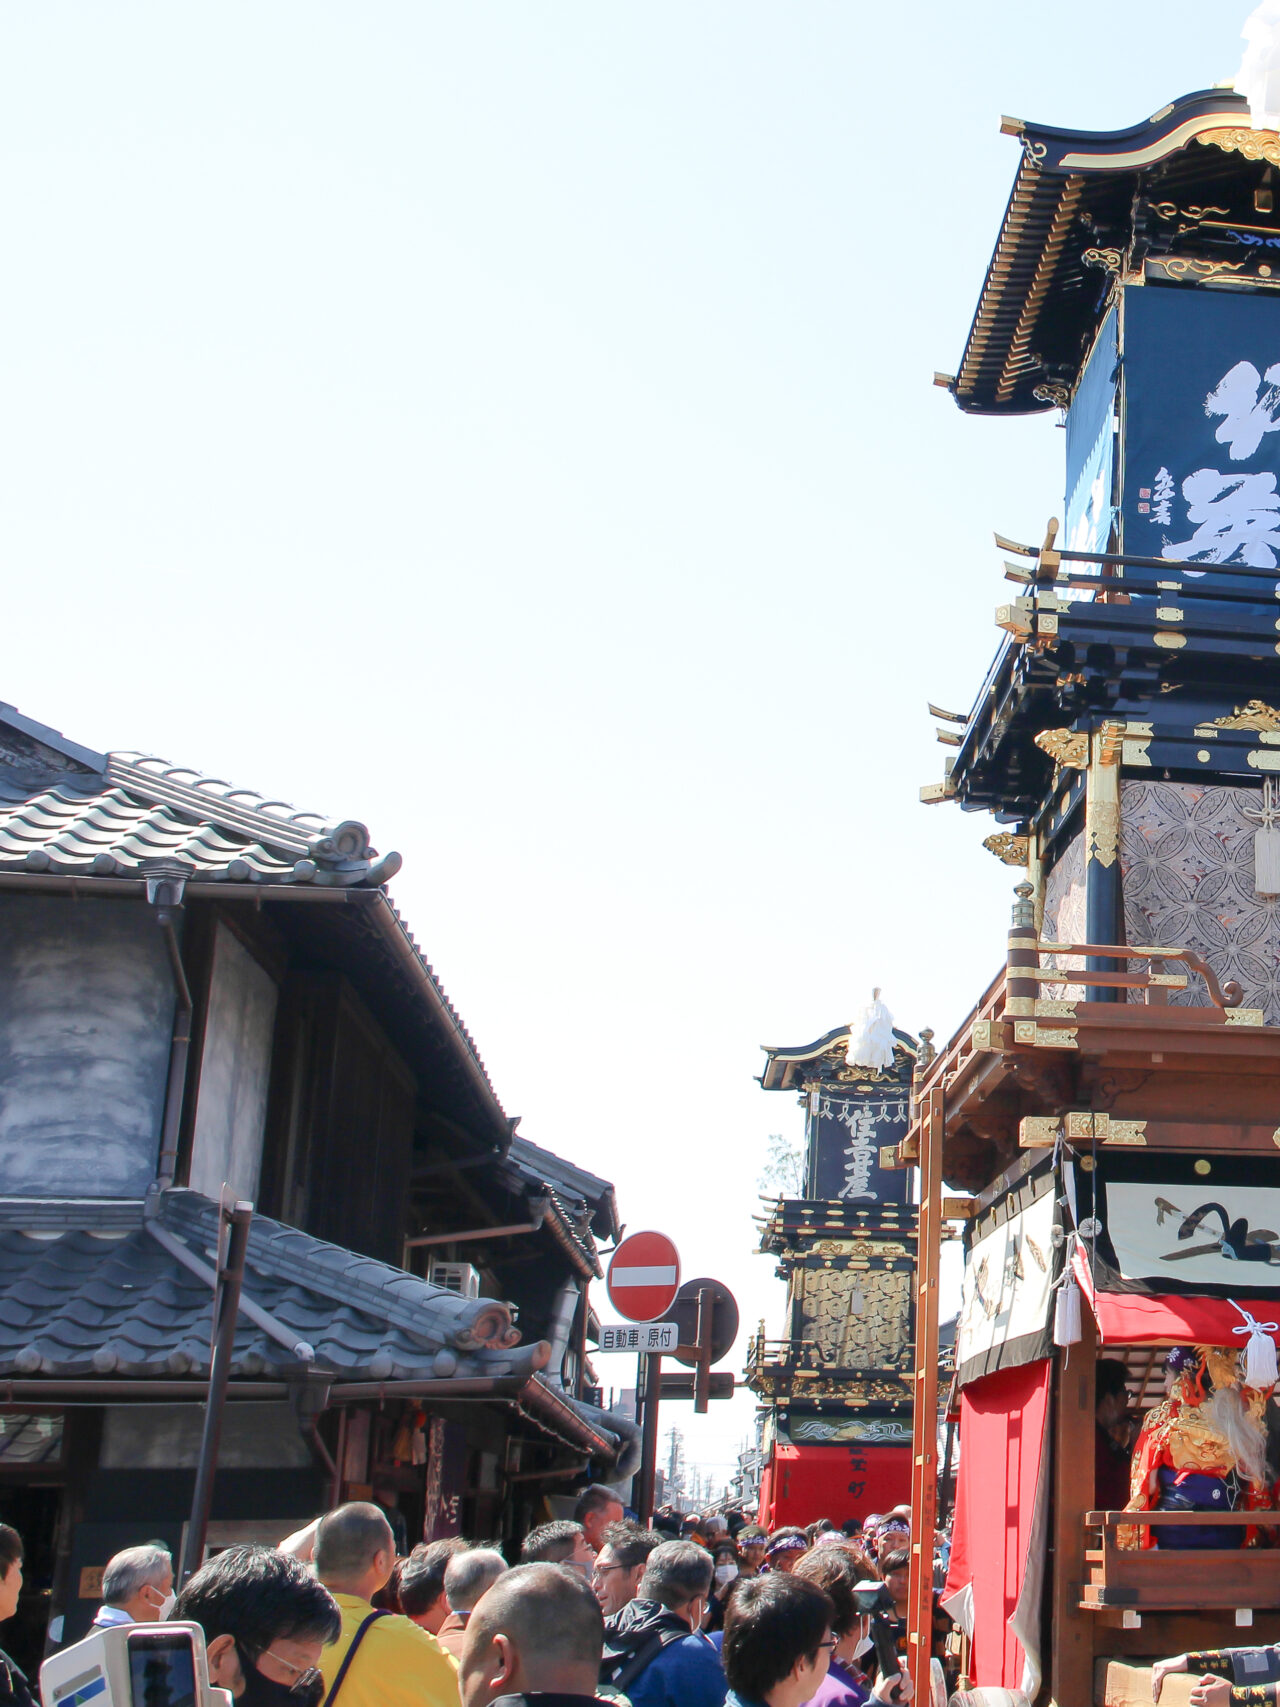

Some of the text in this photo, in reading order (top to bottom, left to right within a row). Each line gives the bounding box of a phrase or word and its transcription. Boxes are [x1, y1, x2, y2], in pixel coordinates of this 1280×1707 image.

[603, 1328, 672, 1349] 自動車・原付
